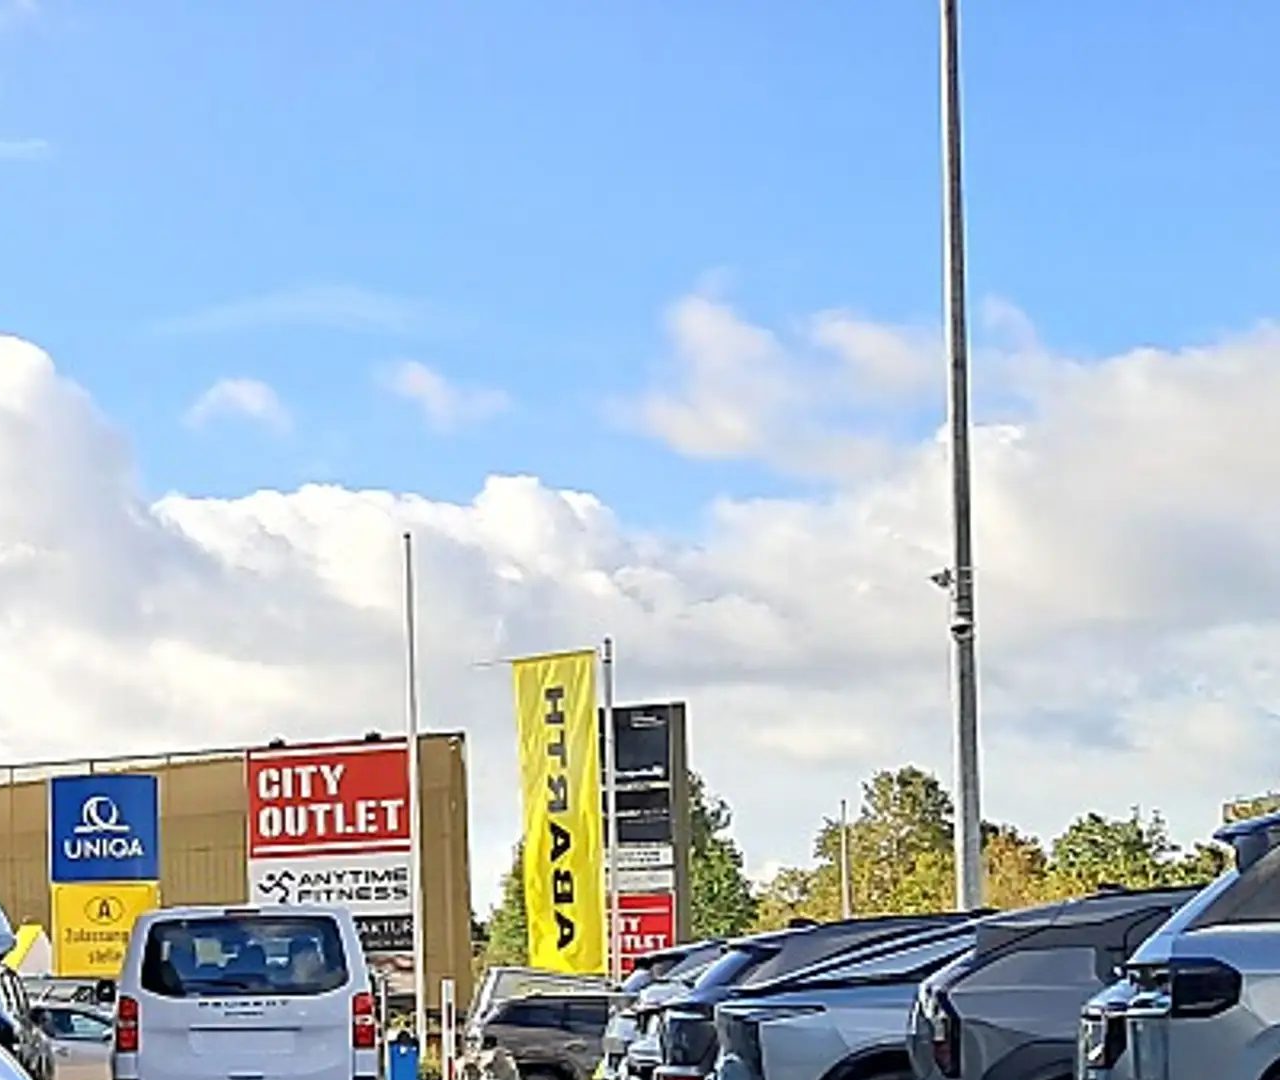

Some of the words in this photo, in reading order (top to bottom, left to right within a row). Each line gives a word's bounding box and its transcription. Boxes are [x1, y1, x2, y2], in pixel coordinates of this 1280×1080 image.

[257, 764, 345, 799] CITY
[257, 799, 405, 838] OUTLET
[63, 837, 144, 860] UNIQA
[298, 867, 408, 887] ANYTIME
[297, 886, 409, 904] FITNESS
[359, 918, 414, 935] AKTUR
[617, 934, 668, 950] TLET
